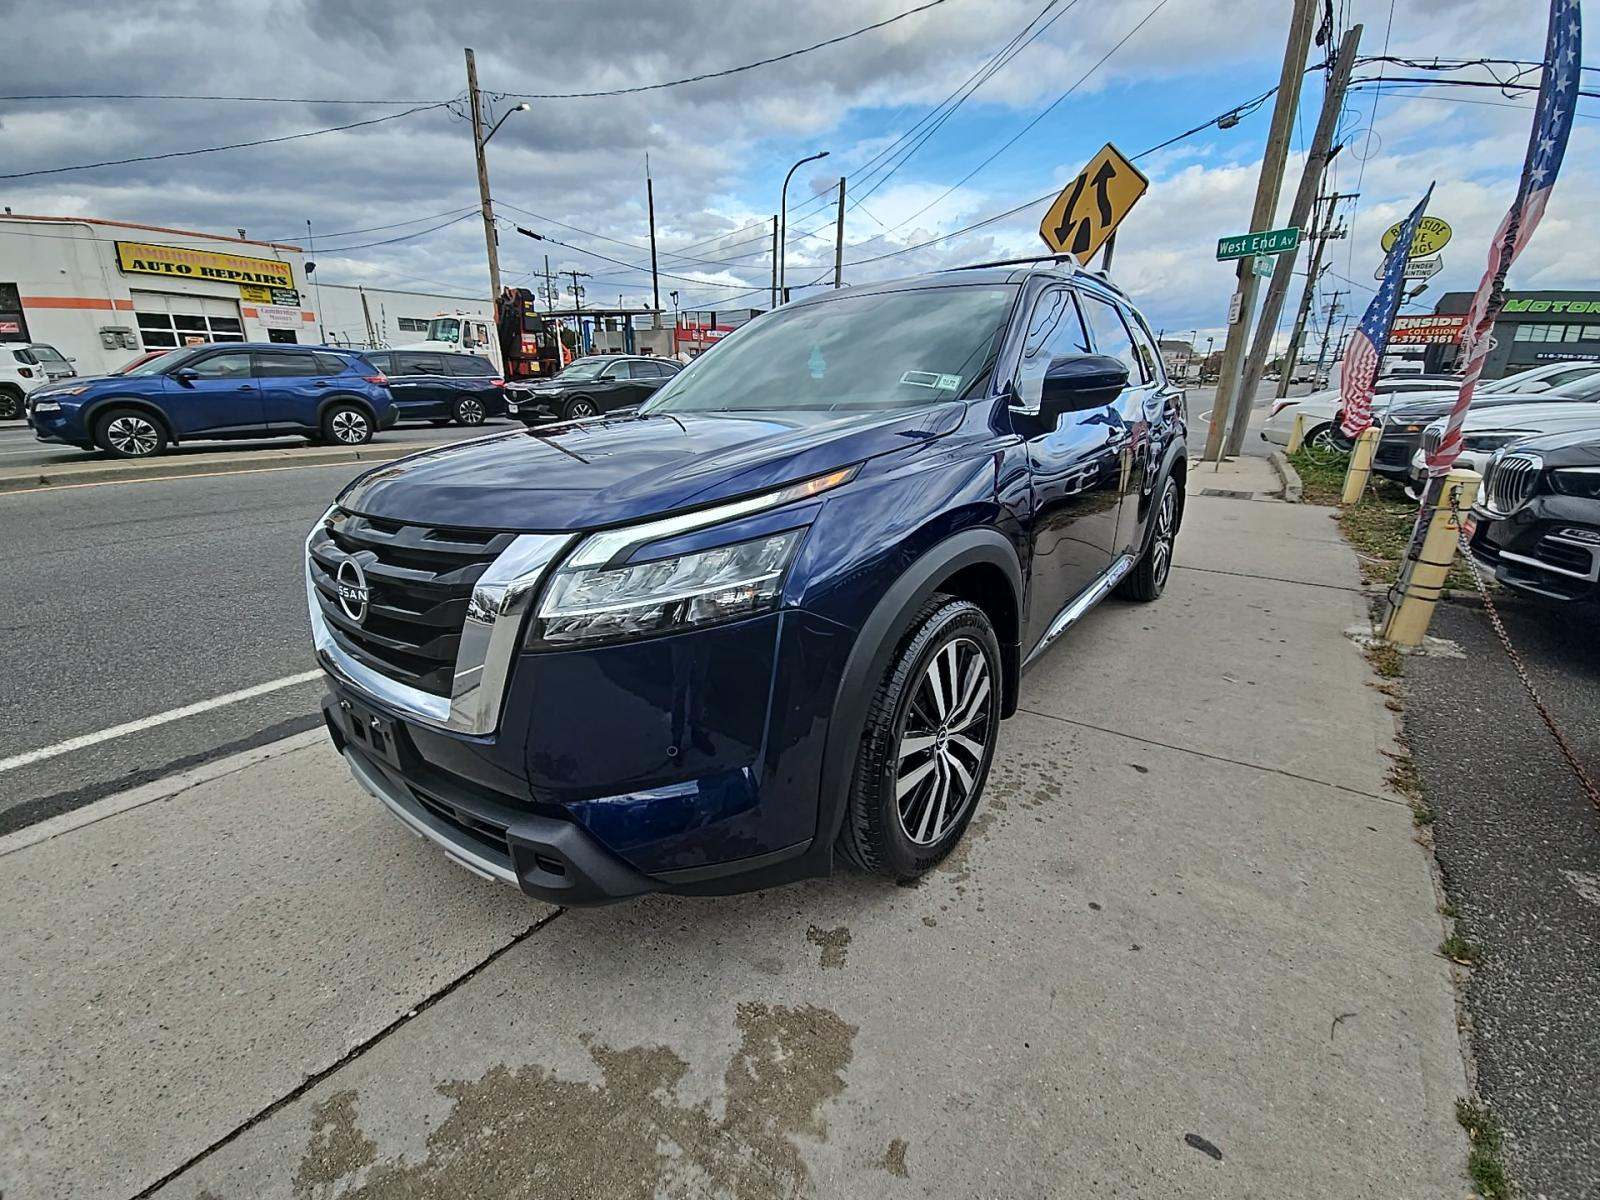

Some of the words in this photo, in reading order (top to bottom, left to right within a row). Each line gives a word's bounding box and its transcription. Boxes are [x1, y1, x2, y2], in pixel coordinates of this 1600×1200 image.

[1219, 240, 1247, 254] West
[1252, 235, 1276, 250] End
[1280, 236, 1294, 247] Av
[132, 259, 191, 274] AUTO
[199, 267, 287, 285] REPAIRS
[1404, 269, 1432, 277] AINTING
[1407, 262, 1434, 270] FENDER
[1392, 317, 1464, 332] RNSIDE
[1408, 328, 1457, 337] COLLISION
[338, 585, 367, 601] SSAN
